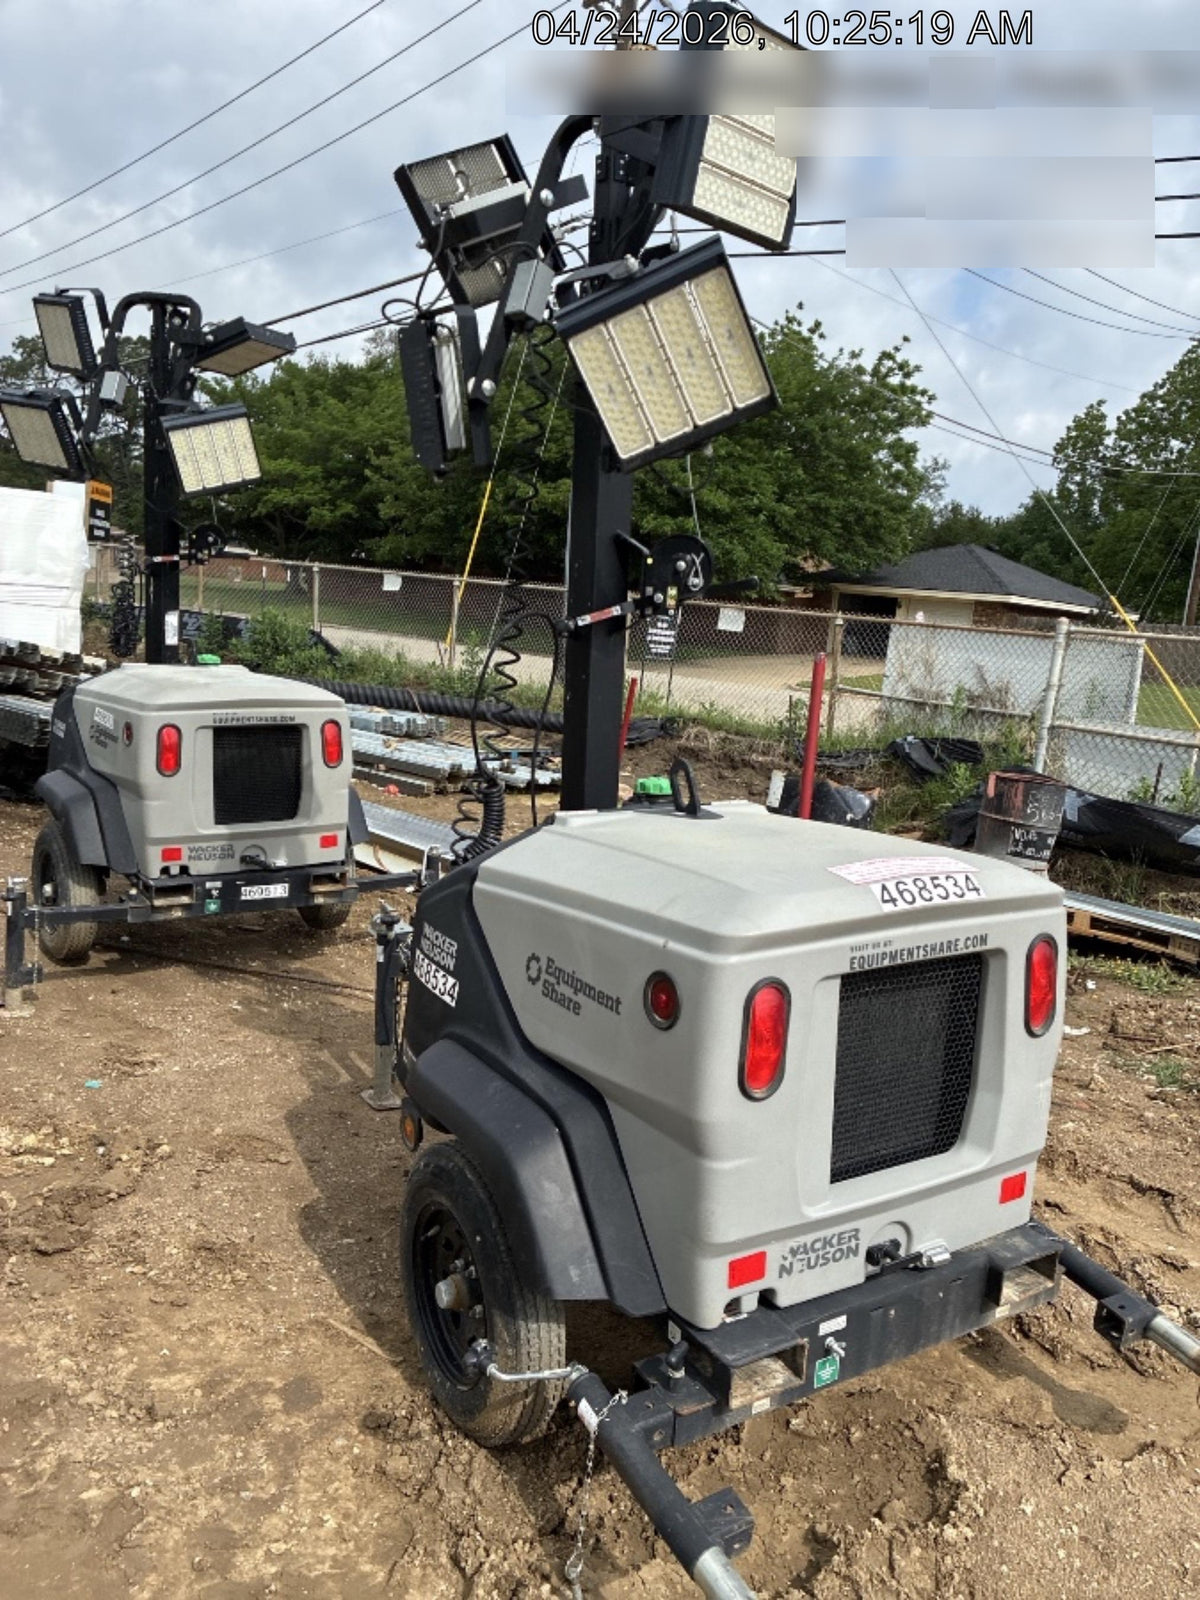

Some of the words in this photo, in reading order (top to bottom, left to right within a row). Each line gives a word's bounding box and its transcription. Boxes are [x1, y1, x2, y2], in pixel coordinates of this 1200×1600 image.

[880, 873, 981, 907] 468534
[850, 933, 989, 971] EQUIPMENTSHARE.COM
[541, 979, 582, 1016] Share
[545, 956, 622, 1016] Equipment
